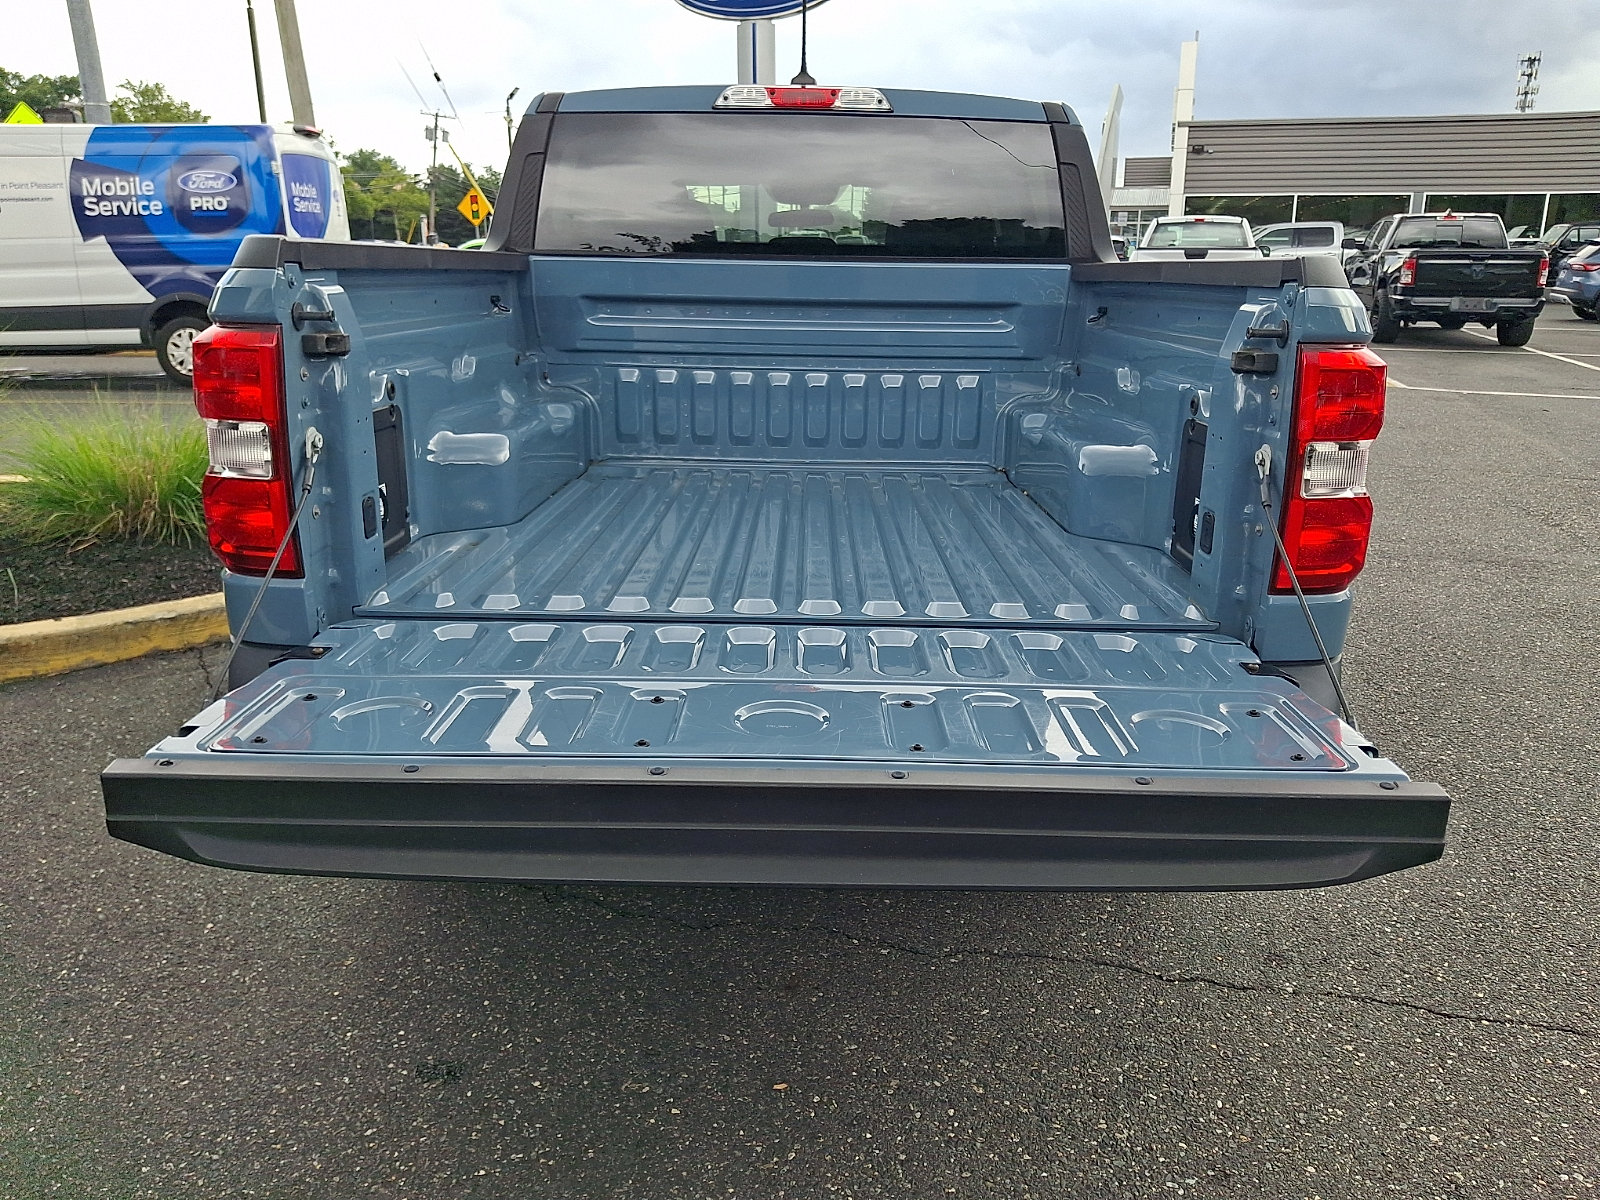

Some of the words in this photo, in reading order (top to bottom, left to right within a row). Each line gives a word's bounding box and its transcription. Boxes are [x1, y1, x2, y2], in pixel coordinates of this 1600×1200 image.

[9, 182, 29, 190] Point
[30, 182, 64, 190] Pleasant
[82, 176, 155, 196] Mobile
[188, 174, 226, 189] Ford
[291, 181, 318, 198] Mobile
[83, 196, 164, 216] Service
[190, 195, 228, 211] PRO
[293, 197, 321, 214] Service
